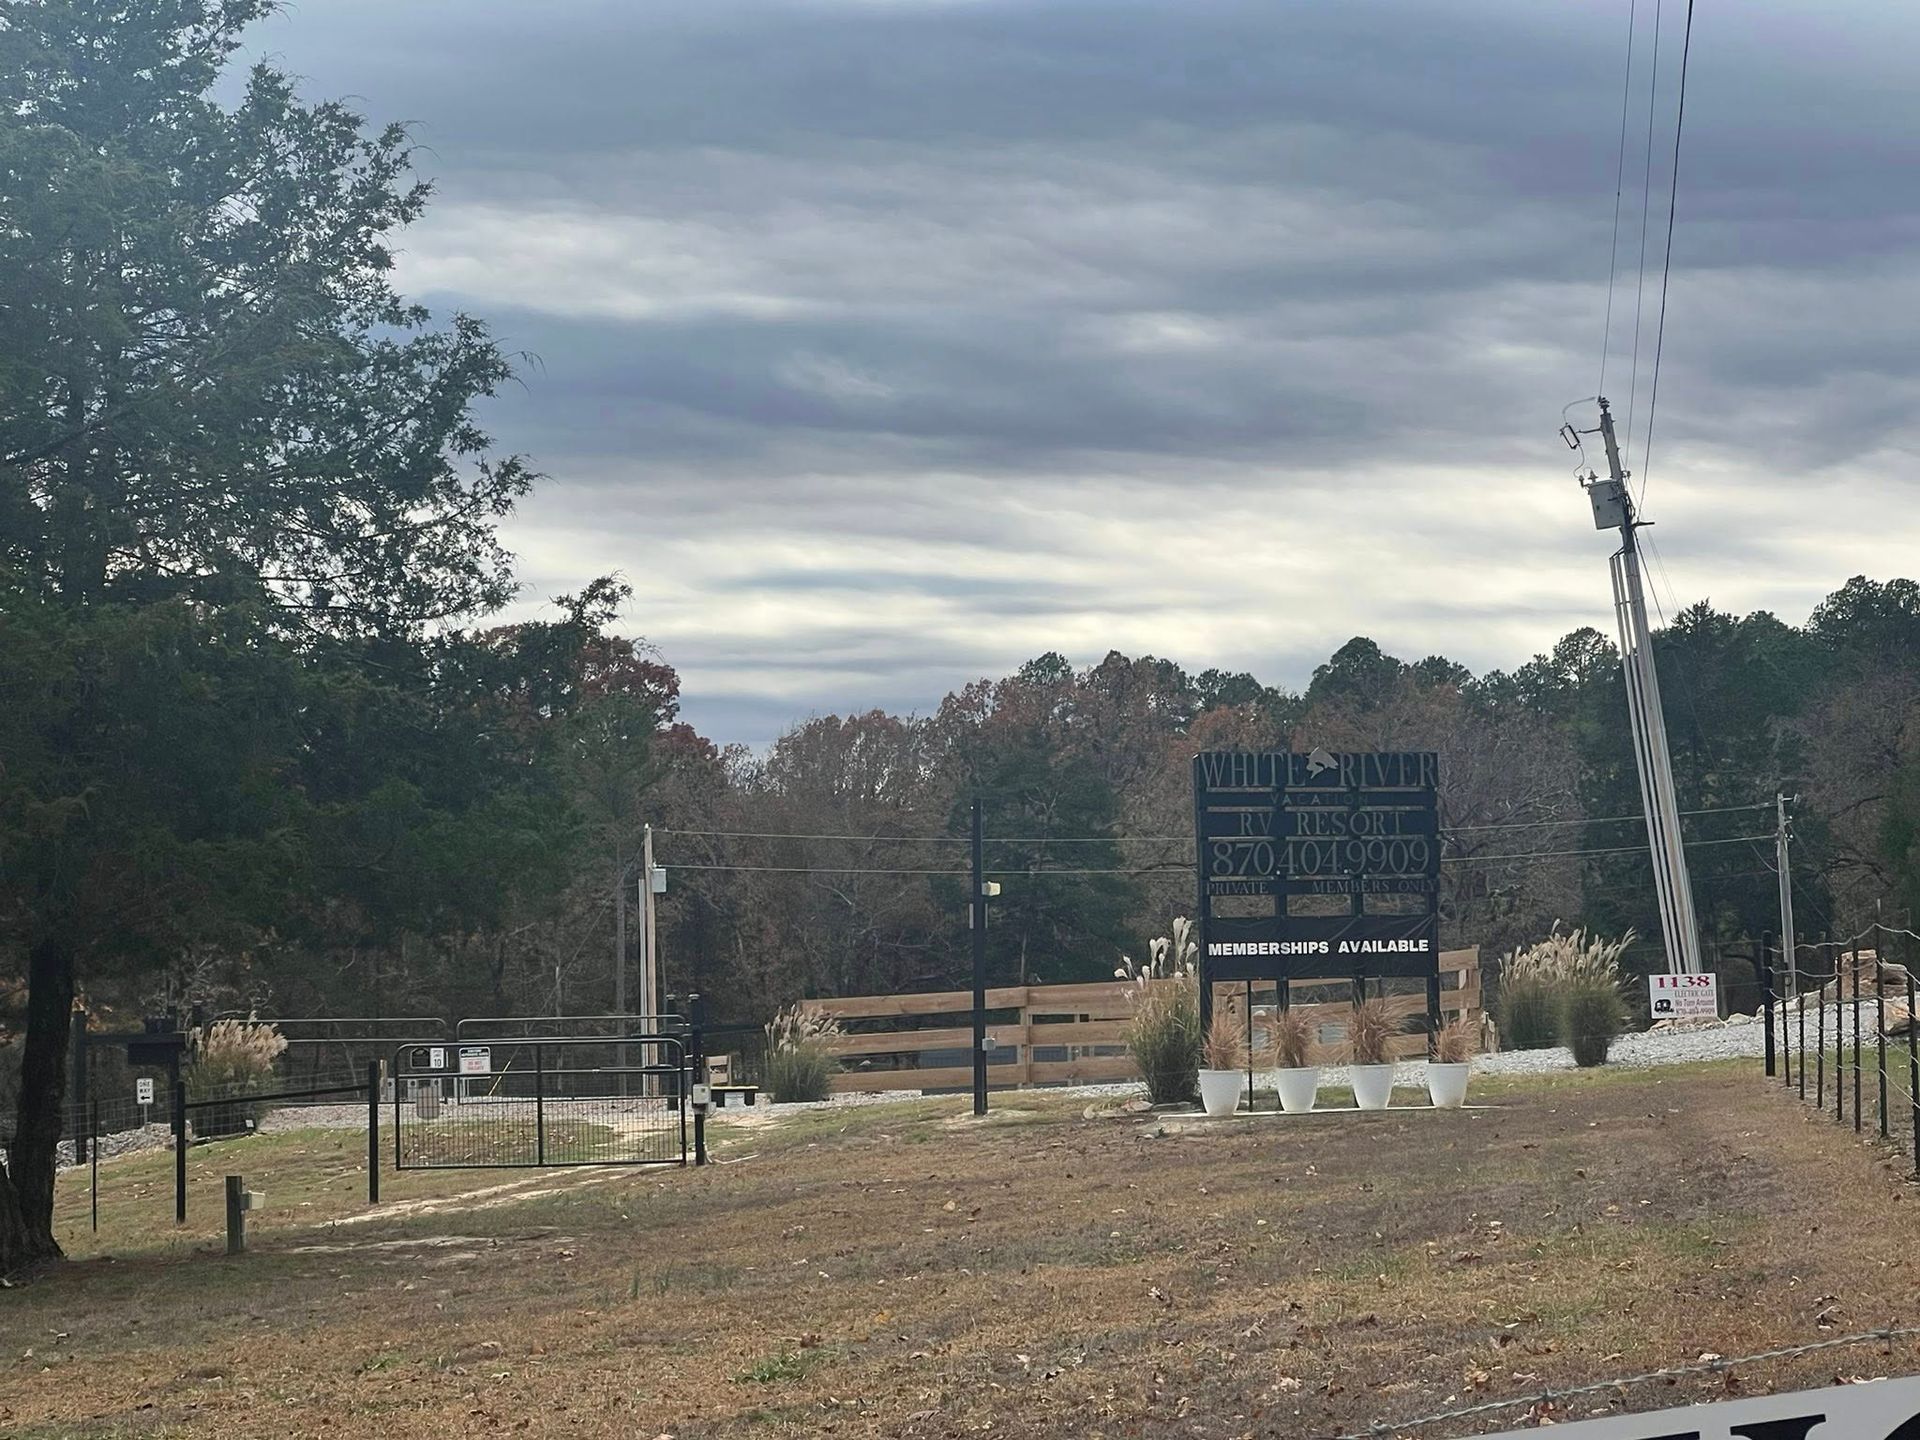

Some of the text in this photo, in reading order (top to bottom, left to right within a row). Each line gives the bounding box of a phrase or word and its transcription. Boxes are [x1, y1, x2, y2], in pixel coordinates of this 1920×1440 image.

[1200, 752, 1438, 787] WHITE RIVER
[1239, 812, 1406, 836] RV RESORT
[1212, 840, 1430, 876] 870.404.9909
[1206, 878, 1436, 895] PRIVATE MEMBERS ONLY
[1208, 939, 1429, 956] MEMBERSHIPS AVAILABLE
[1658, 975, 1710, 989] 1138
